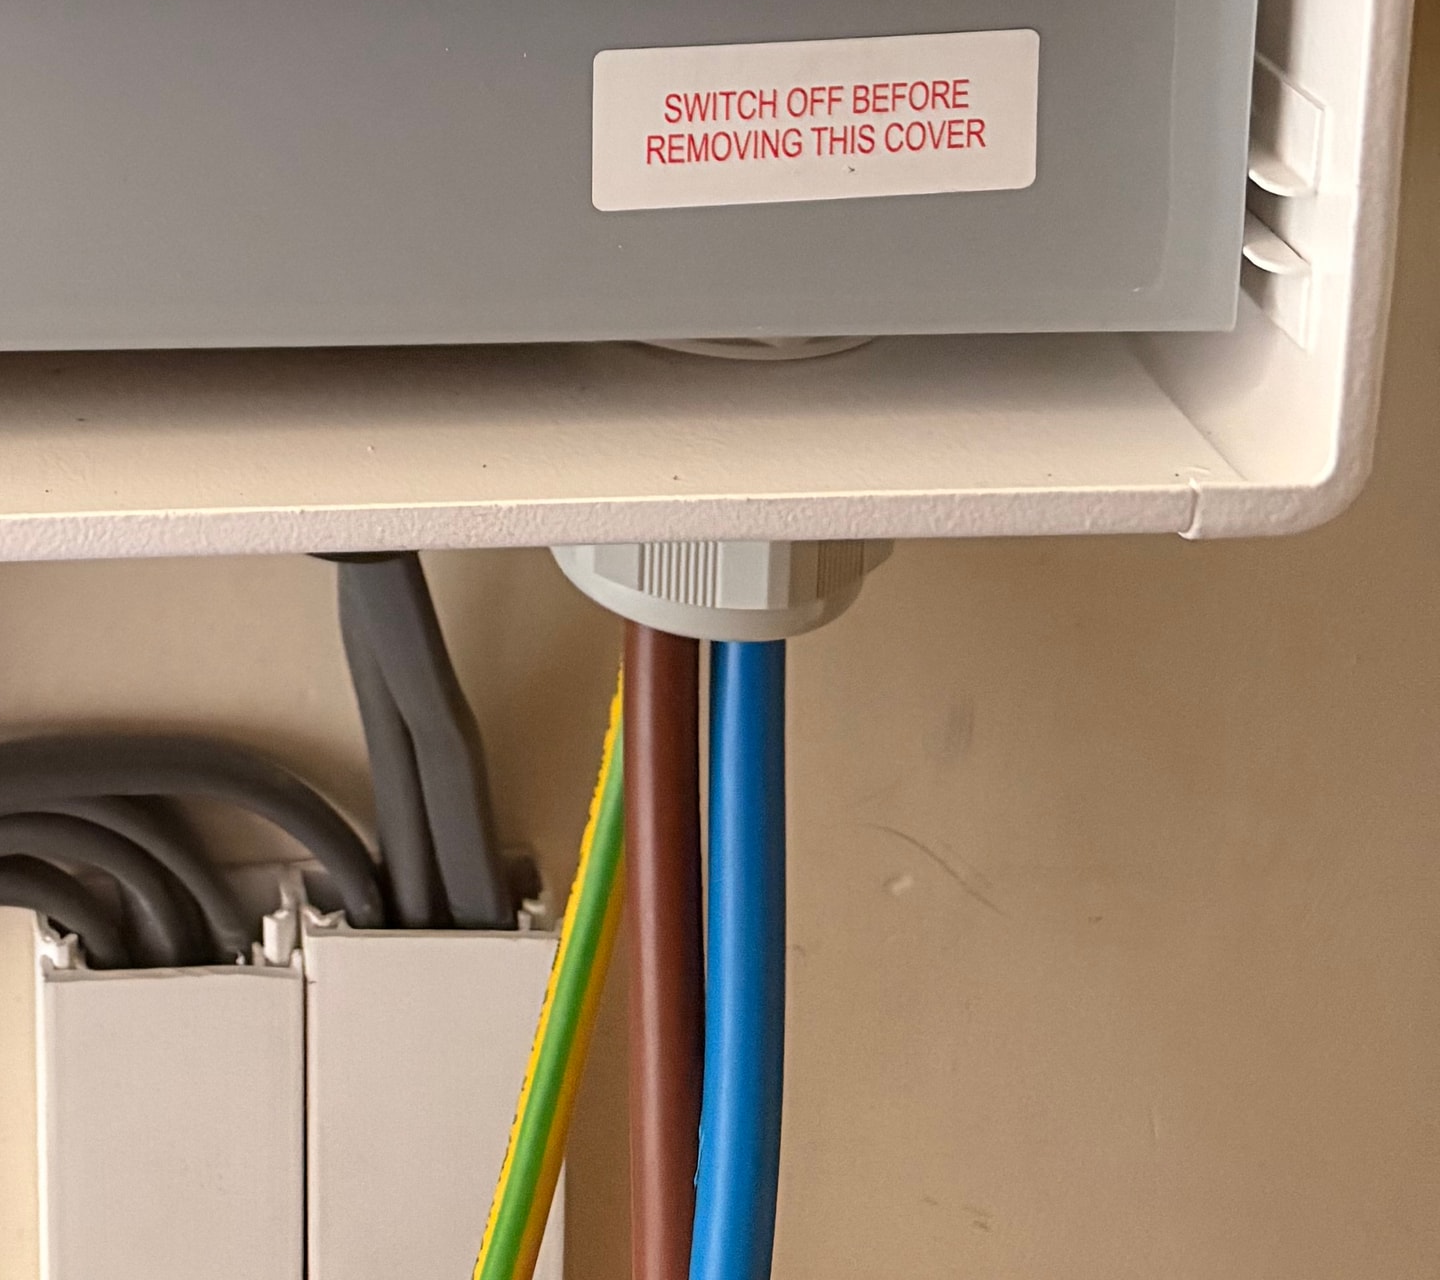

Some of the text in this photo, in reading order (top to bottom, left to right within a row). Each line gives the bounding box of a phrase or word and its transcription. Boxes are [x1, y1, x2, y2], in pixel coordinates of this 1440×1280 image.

[664, 78, 970, 124] SWITCH OFF BEFORE
[646, 118, 986, 165] REMOVING THIS COVER
